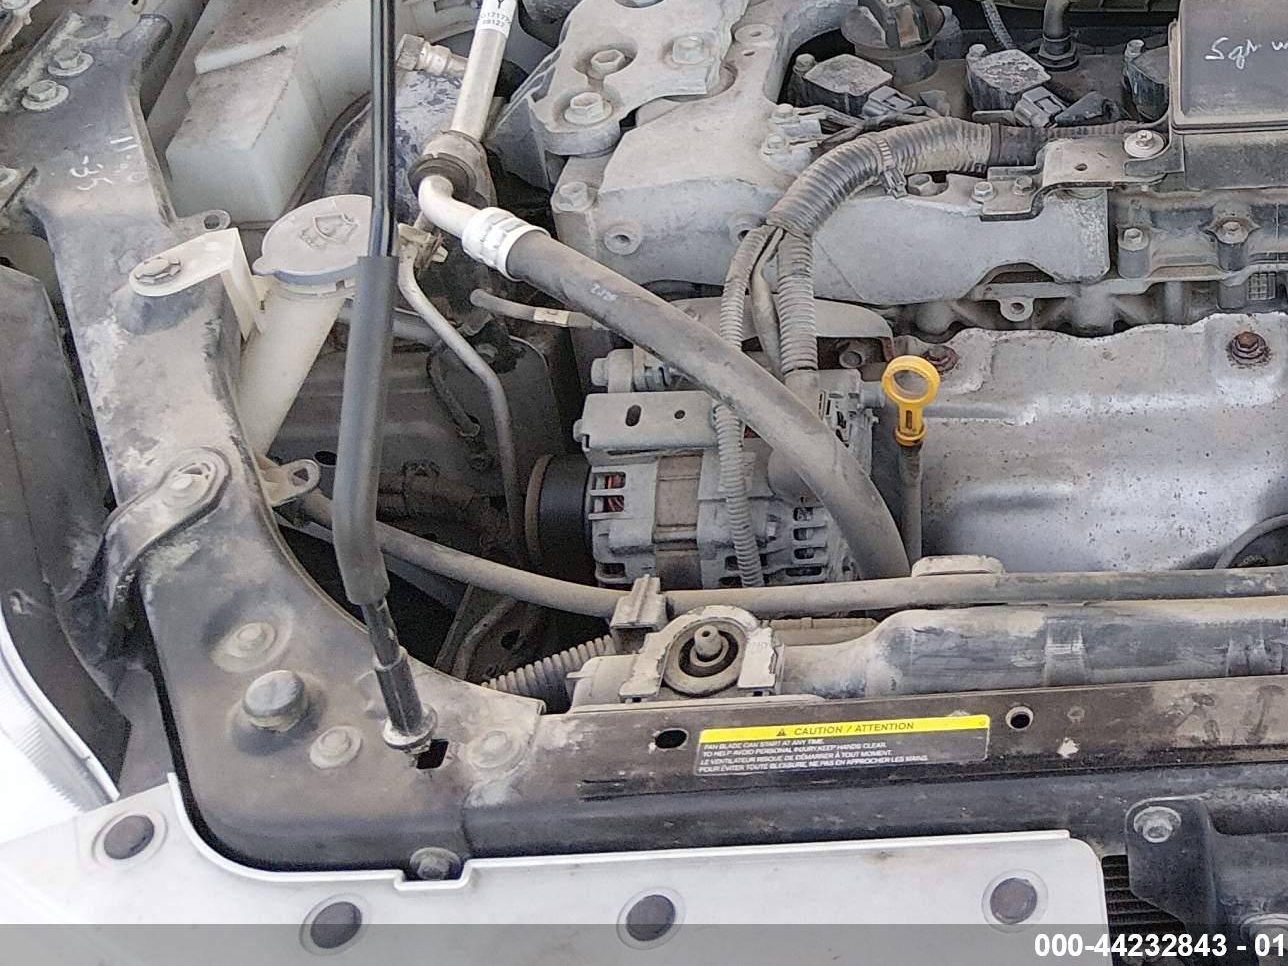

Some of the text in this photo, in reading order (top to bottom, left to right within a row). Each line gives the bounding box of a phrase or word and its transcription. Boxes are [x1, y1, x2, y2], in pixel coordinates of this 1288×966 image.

[794, 726, 843, 736] CAUTION
[855, 722, 914, 732] ATTENTION
[719, 742, 742, 750] BLADE
[743, 741, 759, 749] CAN
[755, 747, 792, 755] PERSONAL
[711, 756, 756, 765] VENTILATEUR
[820, 759, 834, 767] PAS
[846, 757, 891, 766] APPROCHER
